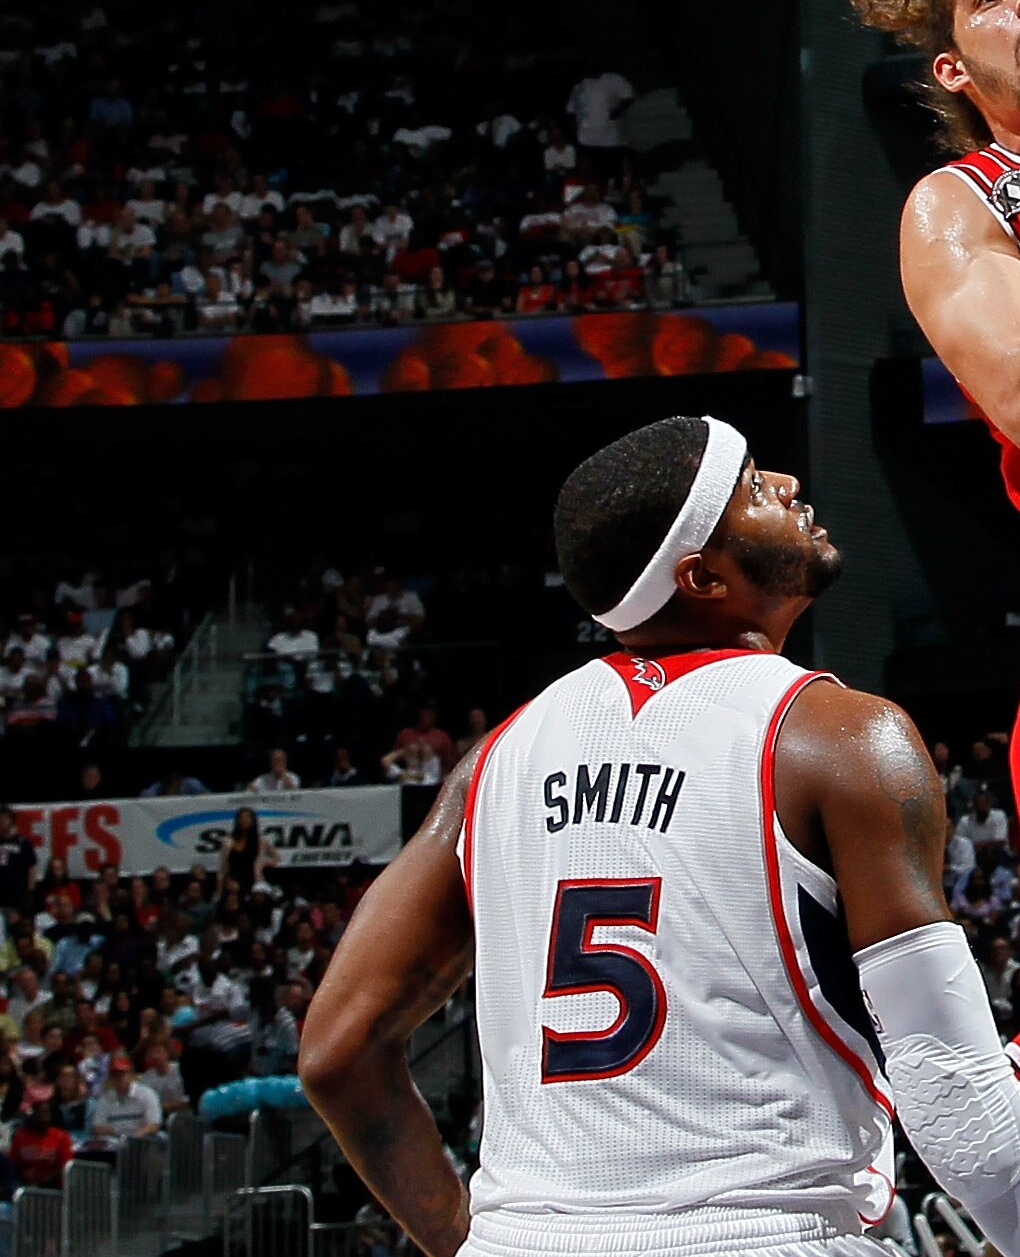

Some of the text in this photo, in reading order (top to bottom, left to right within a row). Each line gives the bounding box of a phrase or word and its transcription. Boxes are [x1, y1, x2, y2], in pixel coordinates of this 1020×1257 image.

[543, 763, 686, 834] SMITH
[194, 822, 353, 854] SANA
[540, 876, 668, 1085] 5
